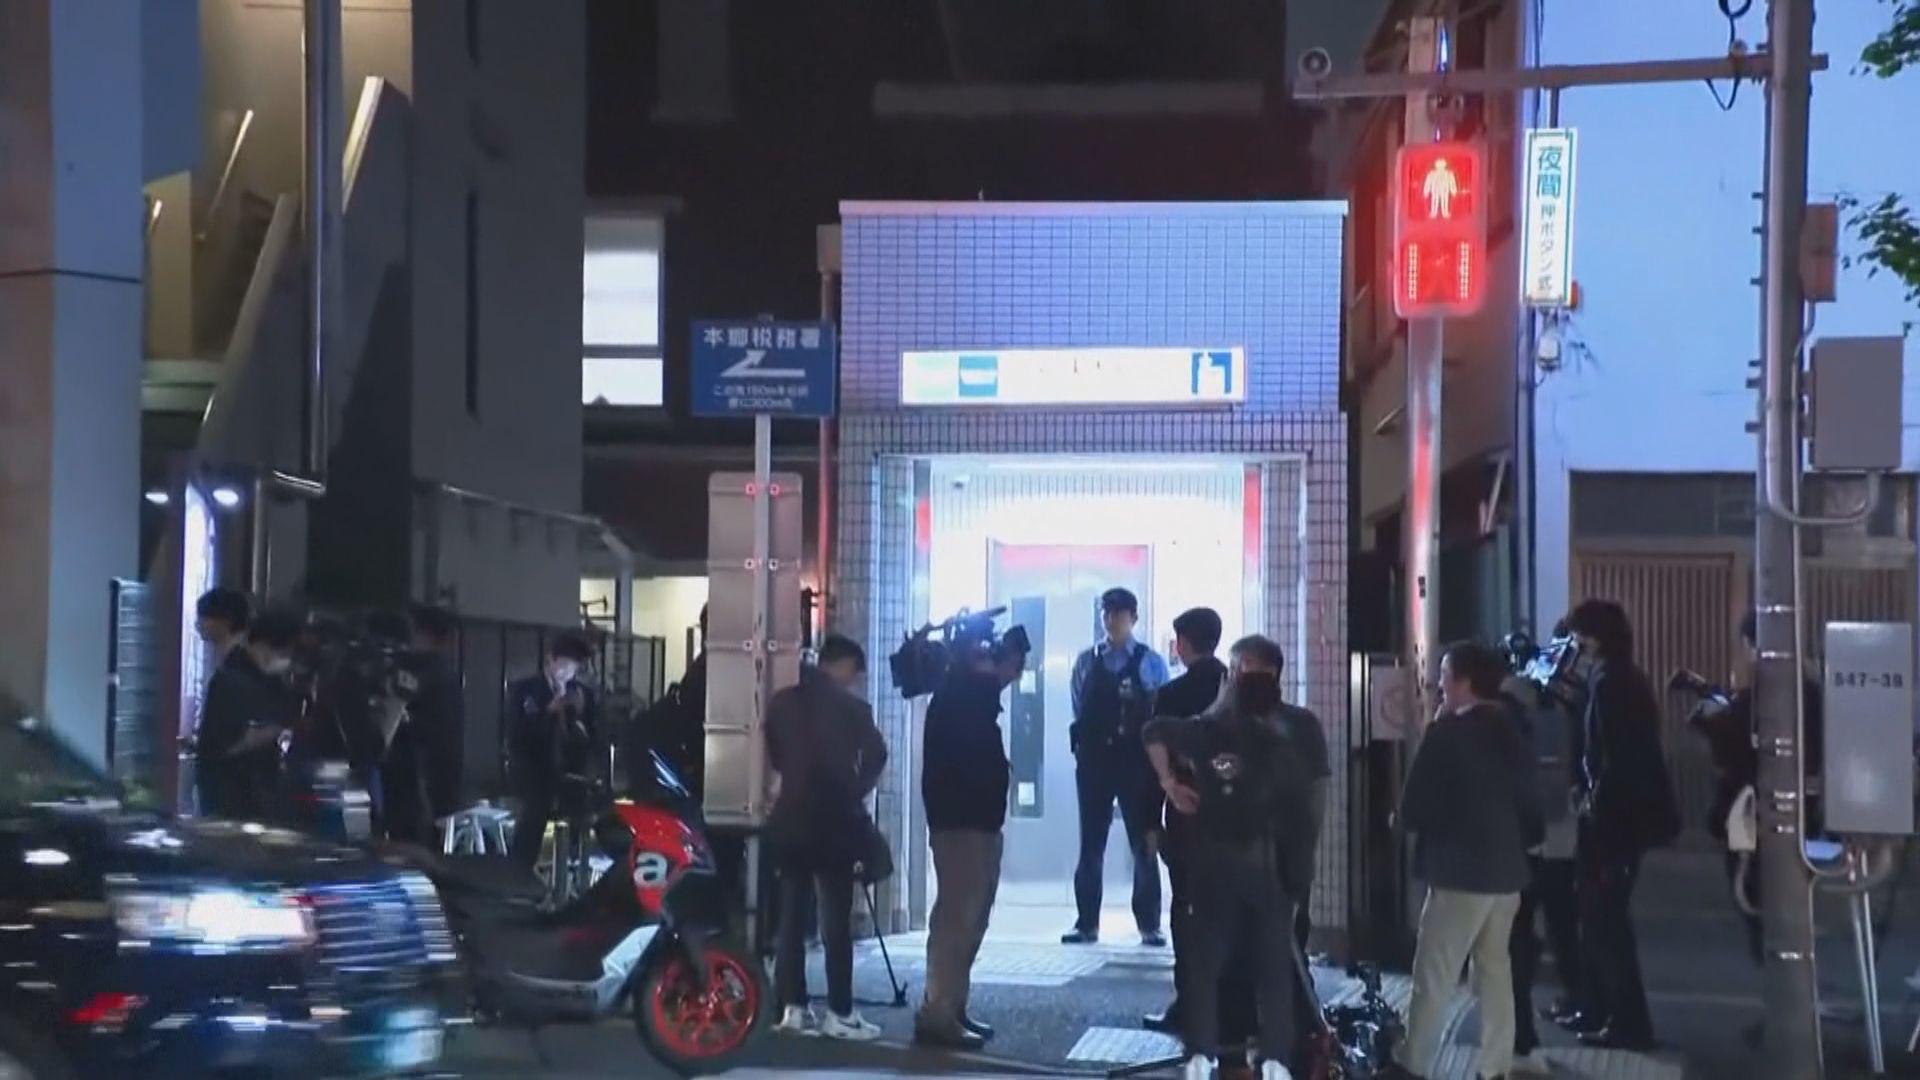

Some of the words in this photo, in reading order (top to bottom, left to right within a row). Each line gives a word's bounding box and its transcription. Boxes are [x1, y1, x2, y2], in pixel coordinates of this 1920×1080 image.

[703, 327, 820, 349] 本郷税務署
[633, 851, 667, 887] a
